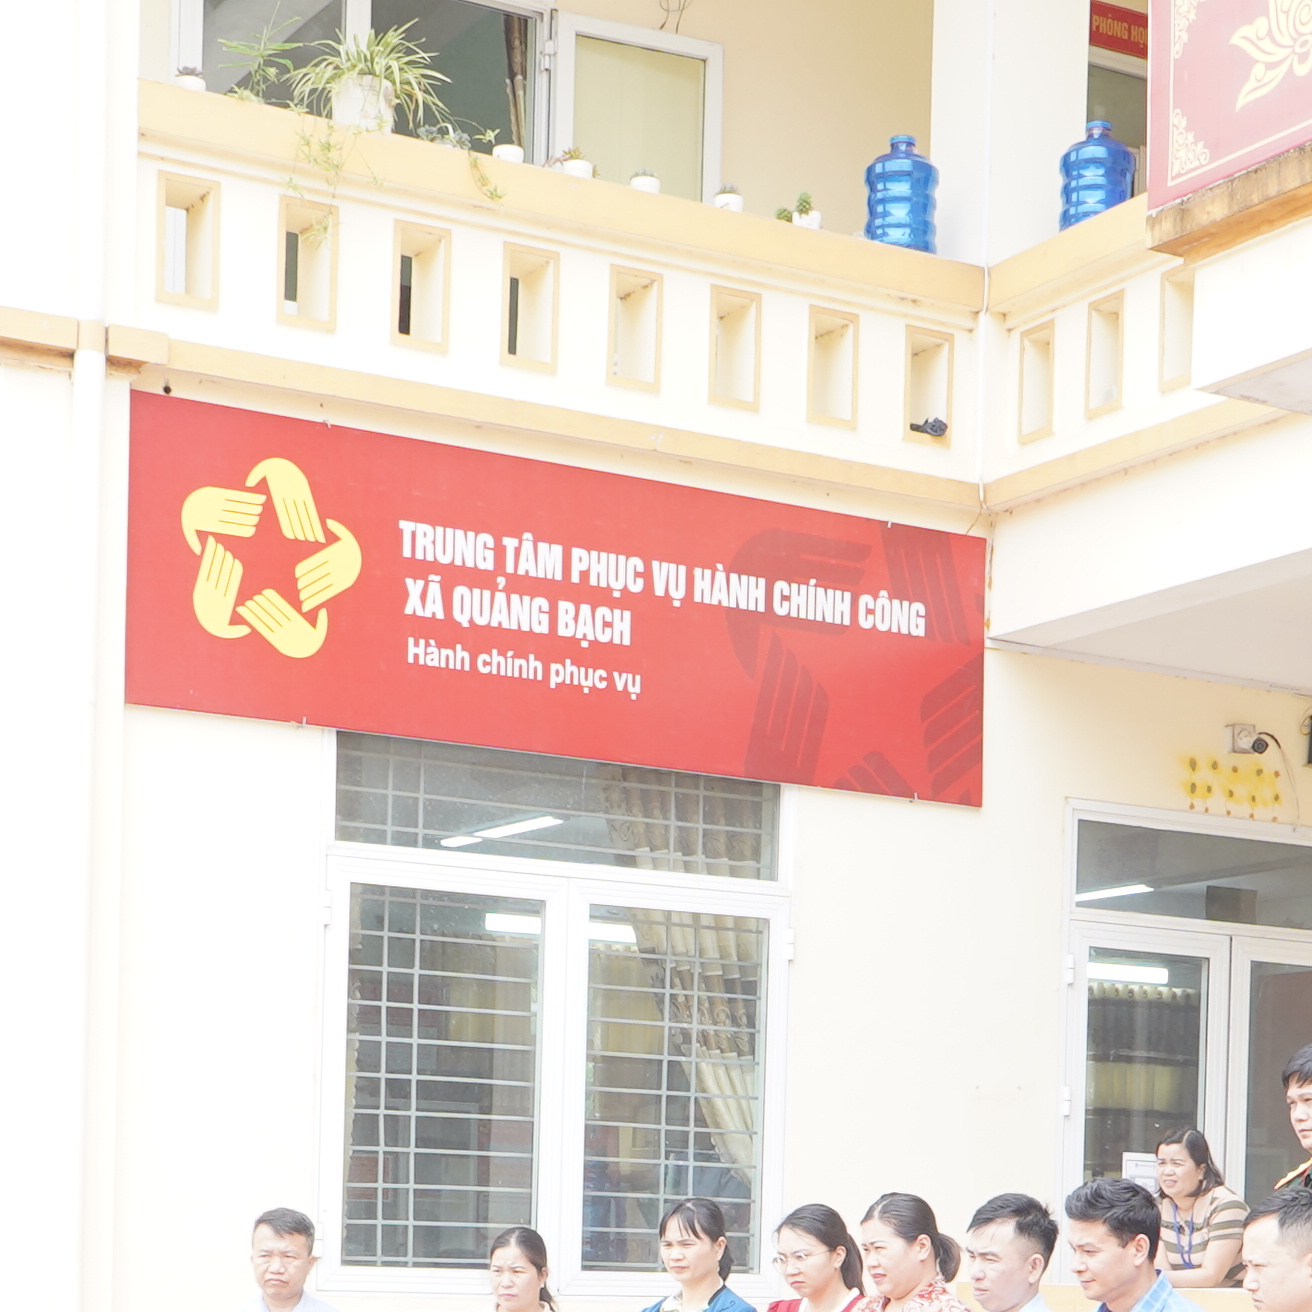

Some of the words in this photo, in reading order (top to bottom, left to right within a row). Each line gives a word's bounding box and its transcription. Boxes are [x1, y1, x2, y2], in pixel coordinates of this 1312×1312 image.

[1092, 13, 1129, 40] PHÒNG
[398, 519, 495, 571] TRUNG
[502, 532, 563, 581] TÂM
[571, 547, 645, 598] PHỤC
[651, 560, 686, 607] VỤ
[694, 563, 766, 612] HÀNH
[772, 578, 852, 626] CHÍNH
[858, 589, 926, 637] CÔNG
[404, 574, 445, 620] XÃ
[452, 576, 550, 634] QUẢNG
[557, 600, 632, 648] BẠCH
[407, 637, 470, 671] Hành
[477, 648, 543, 681] chính
[549, 658, 608, 694] phục
[613, 671, 642, 700] vụ
